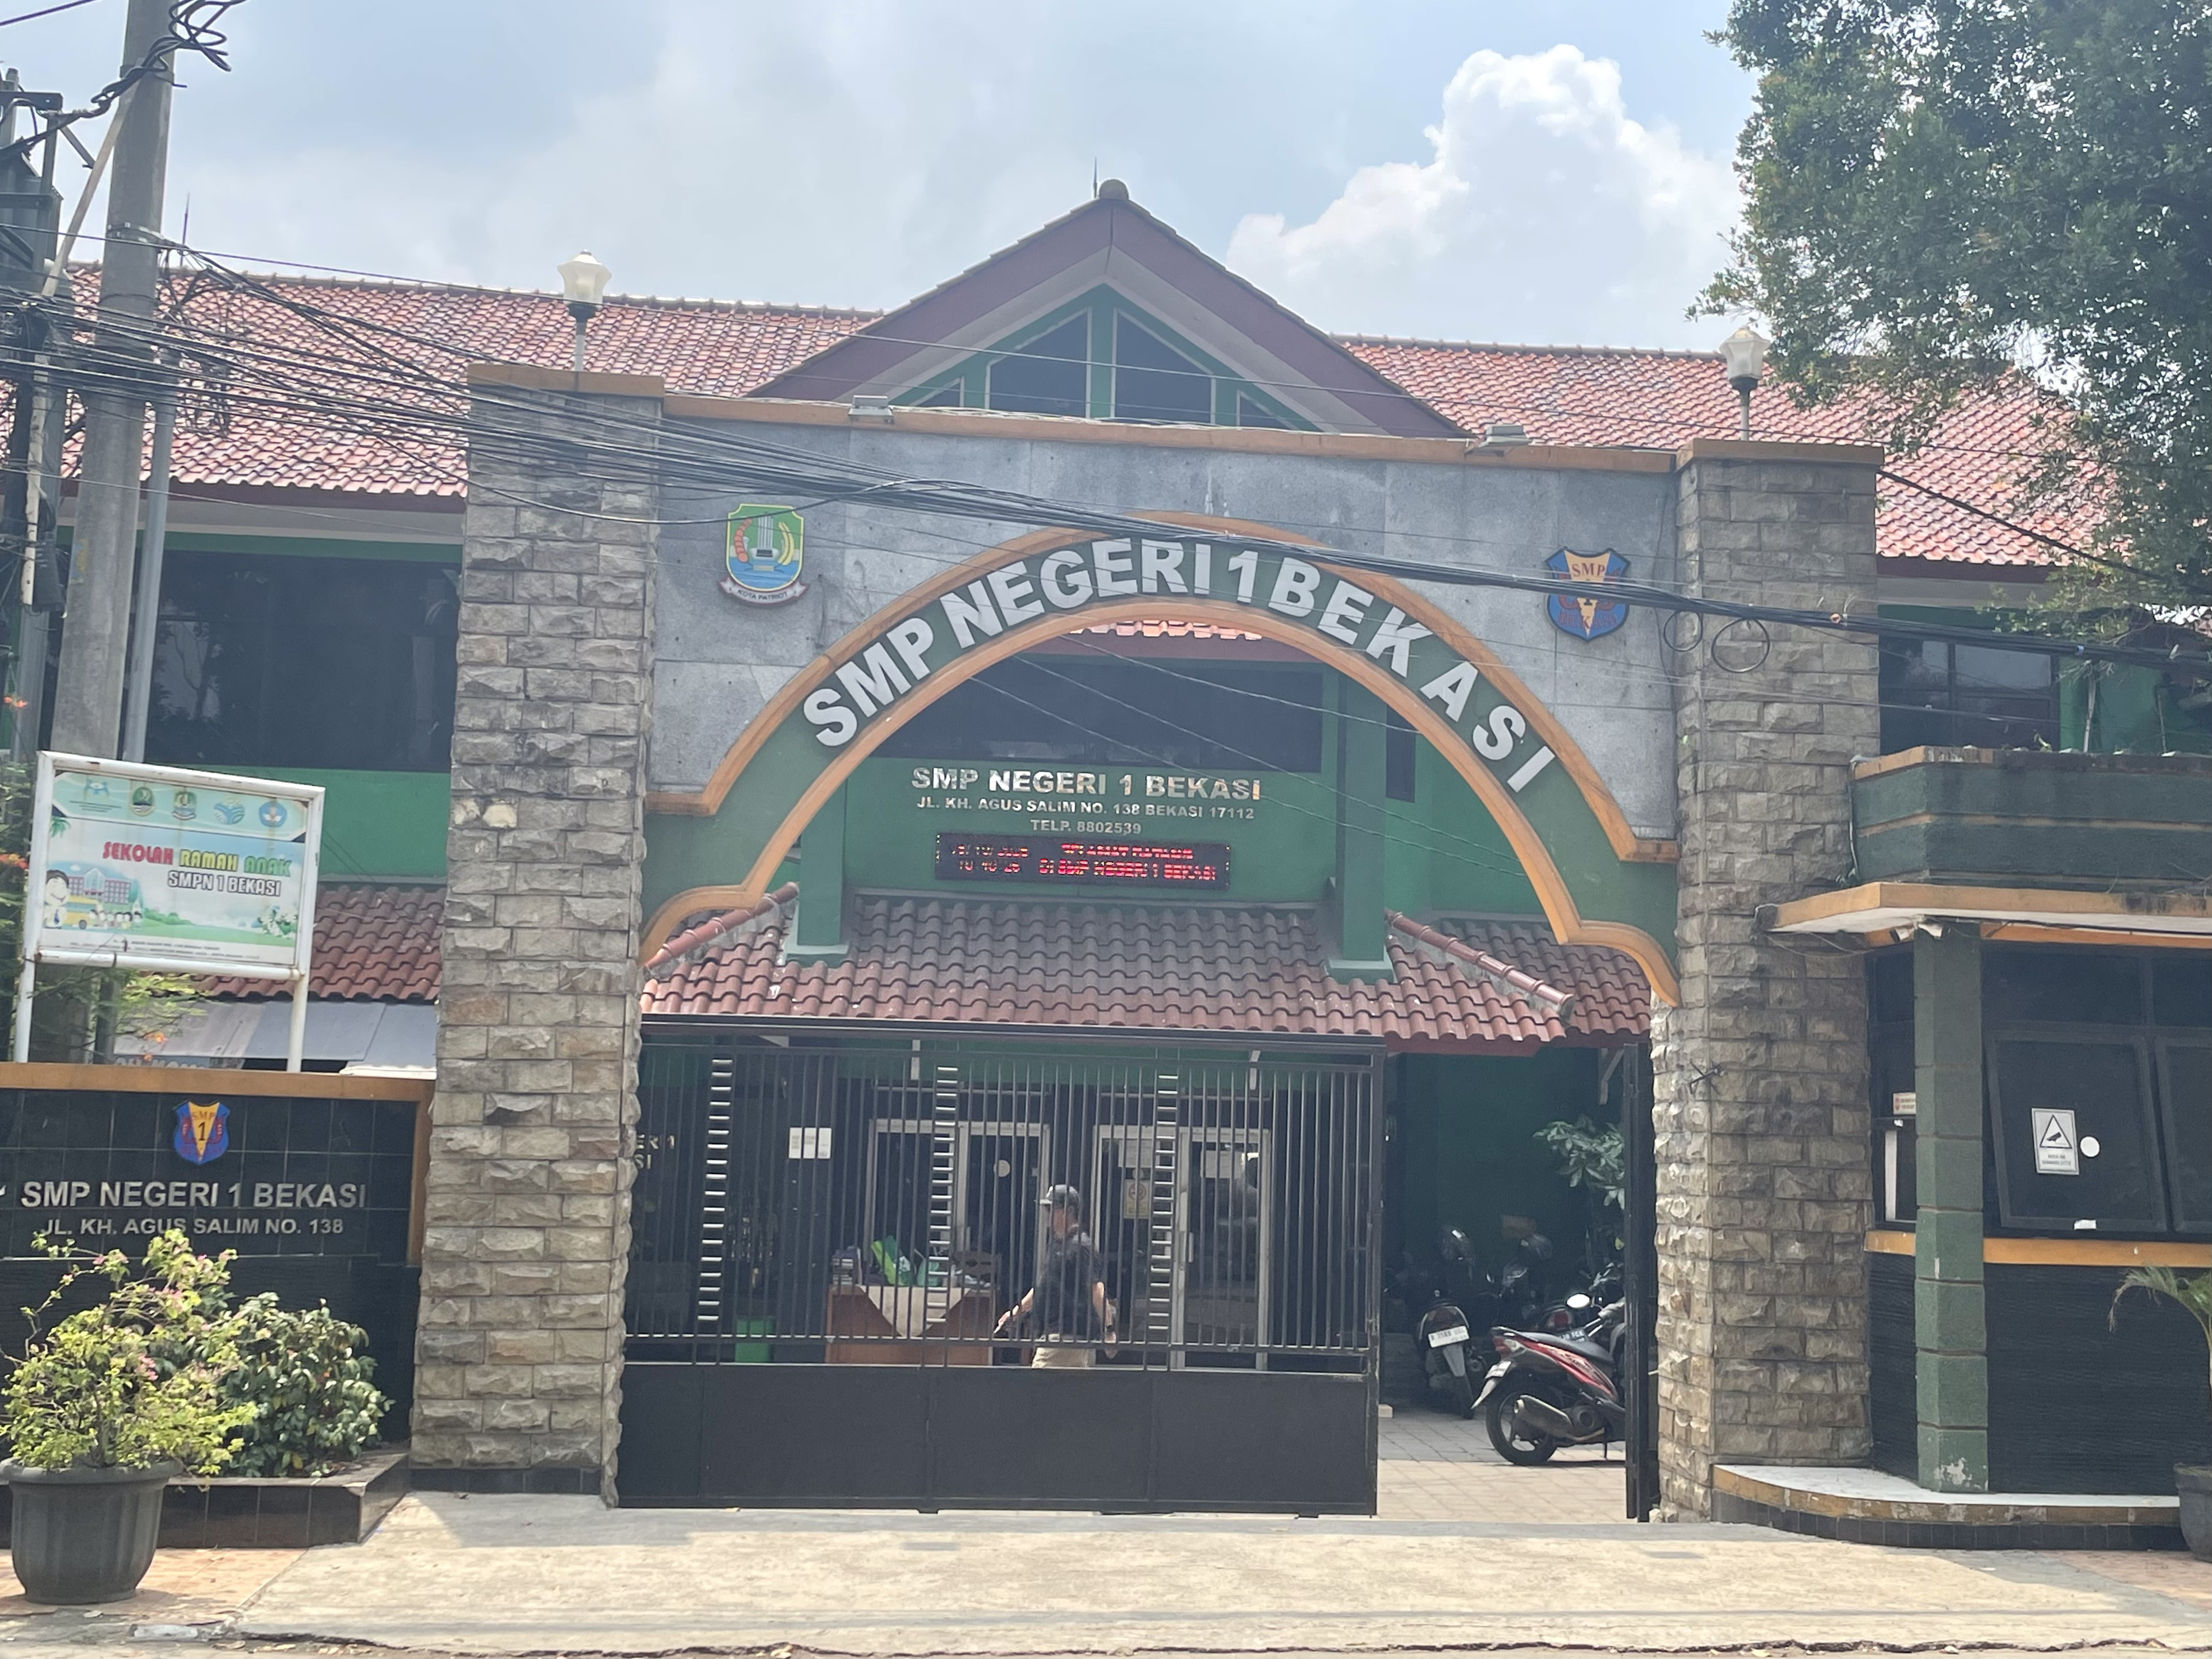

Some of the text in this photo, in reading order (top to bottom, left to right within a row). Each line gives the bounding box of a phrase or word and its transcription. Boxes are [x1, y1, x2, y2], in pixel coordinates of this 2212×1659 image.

[1571, 563, 1605, 577] SMP
[737, 589, 788, 600] KOTA PATRIOT
[803, 538, 1555, 793] SMP NEGERI 1 BEKASI
[911, 767, 1260, 800] SMP NEGERI 1 BEKASI
[917, 796, 1255, 819] JL. KH. AGUS SALIM NO. 138 BEKASI 17112
[1030, 819, 1141, 834] TELP. 8802539
[102, 841, 293, 877] SEKOLAH RAMAH ANAK
[167, 870, 281, 897] SMPN 1 BEKASI
[198, 1121, 206, 1141] 1
[21, 1181, 366, 1208] SMP NEGERI 1 BEKASI
[44, 1217, 344, 1235] JL. KH. AGUS SALIM NO. 138
